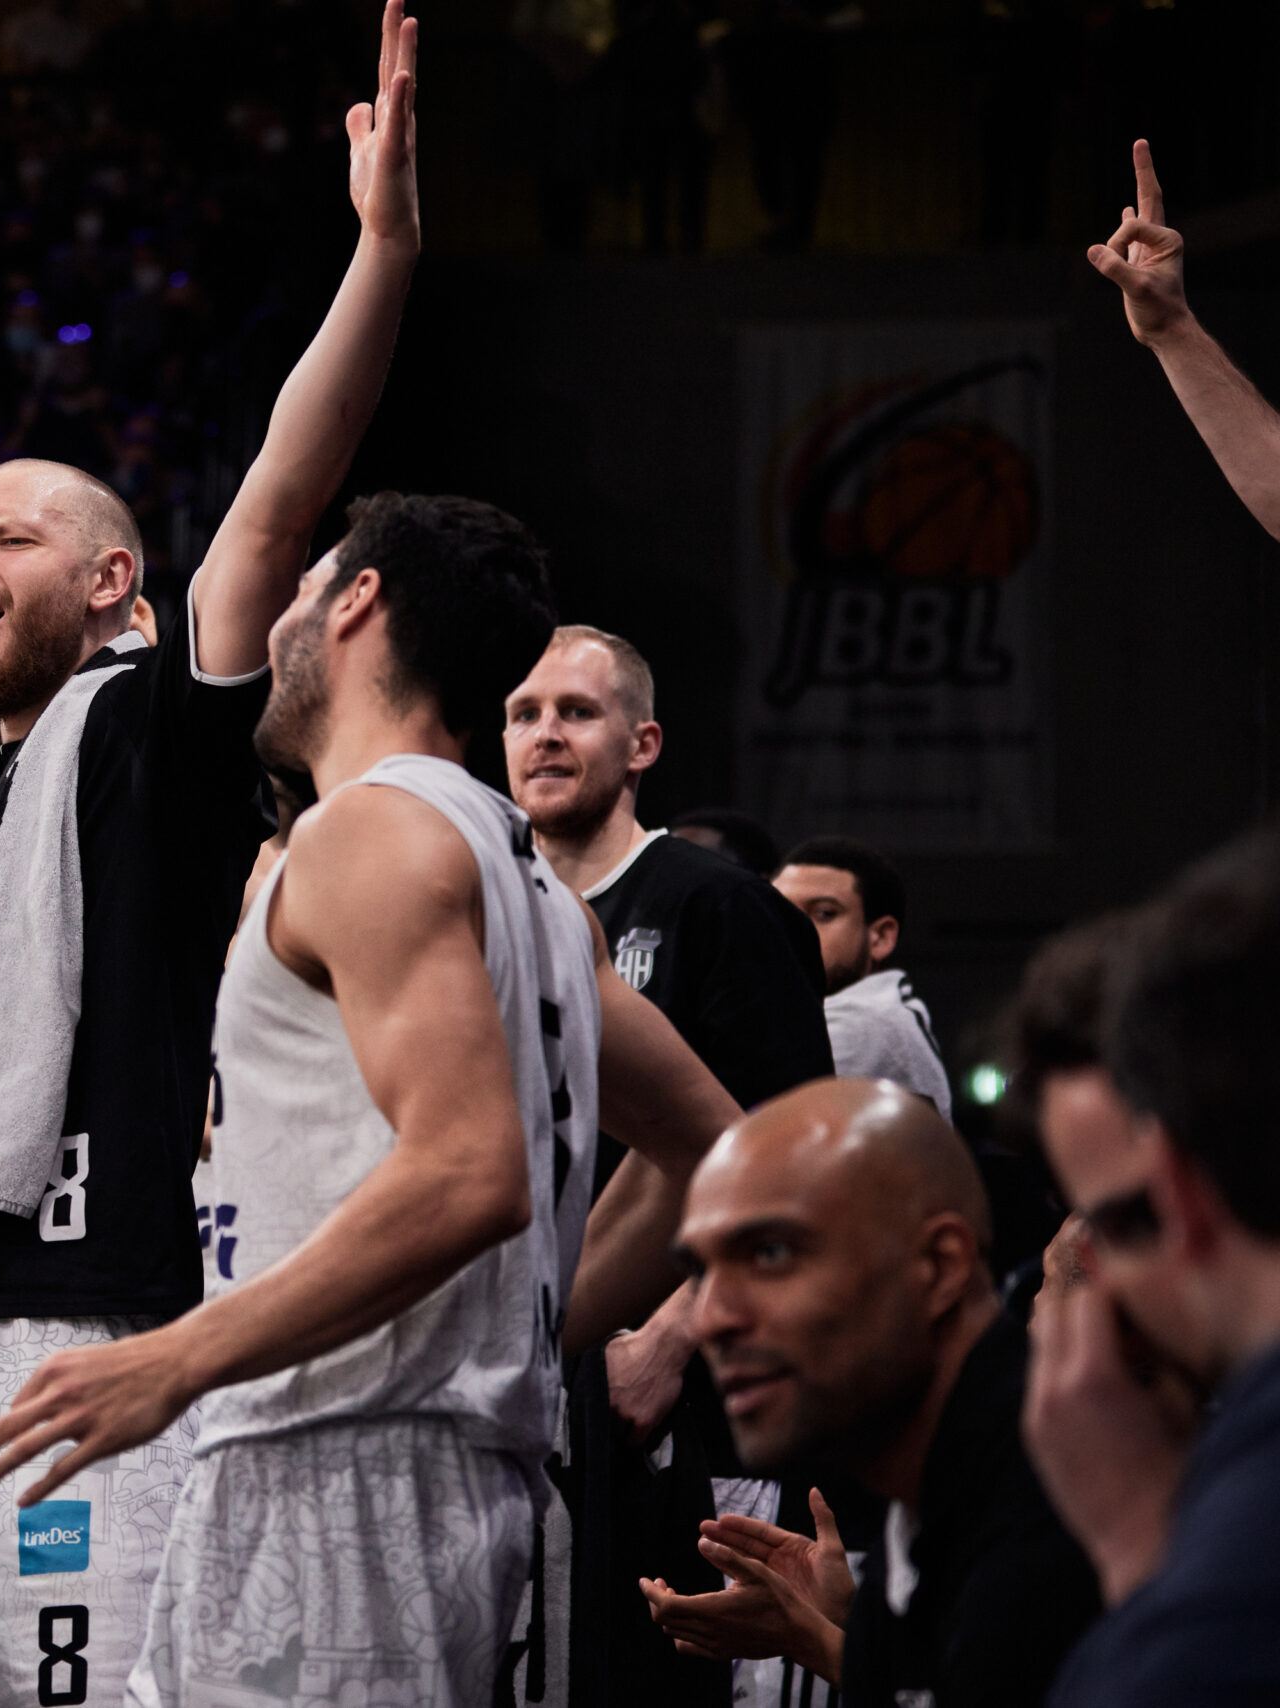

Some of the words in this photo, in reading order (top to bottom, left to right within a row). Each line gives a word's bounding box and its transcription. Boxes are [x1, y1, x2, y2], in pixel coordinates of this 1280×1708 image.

[766, 582, 1012, 706] JBBL
[39, 1132, 89, 1242] 8
[24, 1527, 81, 1547] LinkDes
[38, 1604, 89, 1707] 8
